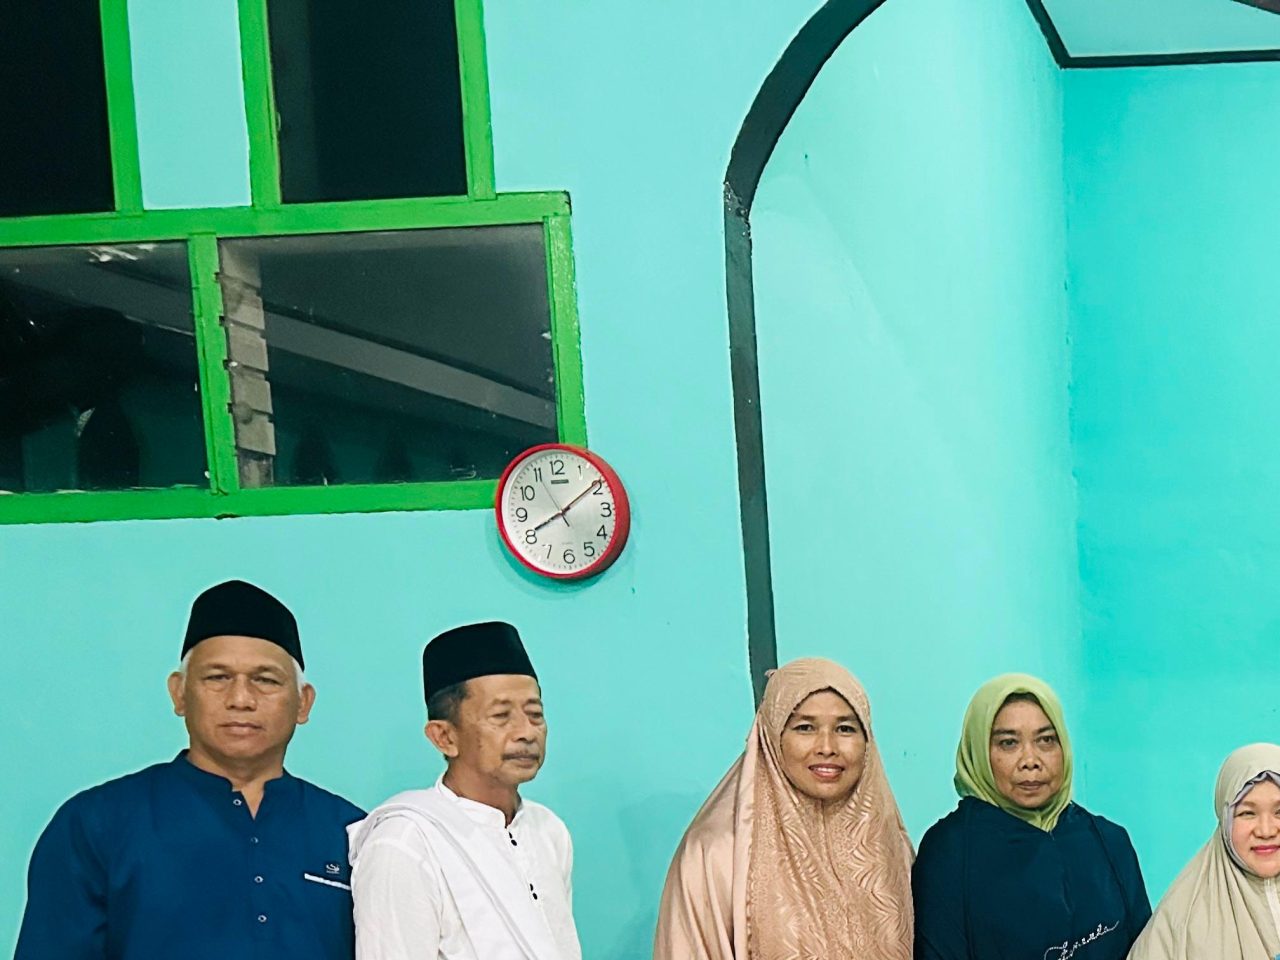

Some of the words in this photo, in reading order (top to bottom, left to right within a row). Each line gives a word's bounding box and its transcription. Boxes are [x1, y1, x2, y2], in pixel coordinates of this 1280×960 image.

[533, 467, 542, 482] 11
[549, 460, 565, 475] 12
[520, 485, 535, 501] 10
[592, 480, 603, 495] 2
[516, 508, 528, 522] 9
[600, 502, 612, 517] 3
[525, 529, 537, 544] 8
[597, 525, 607, 539] 4
[542, 544, 552, 559] 7
[583, 541, 595, 556] 5
[563, 549, 575, 564] 6
